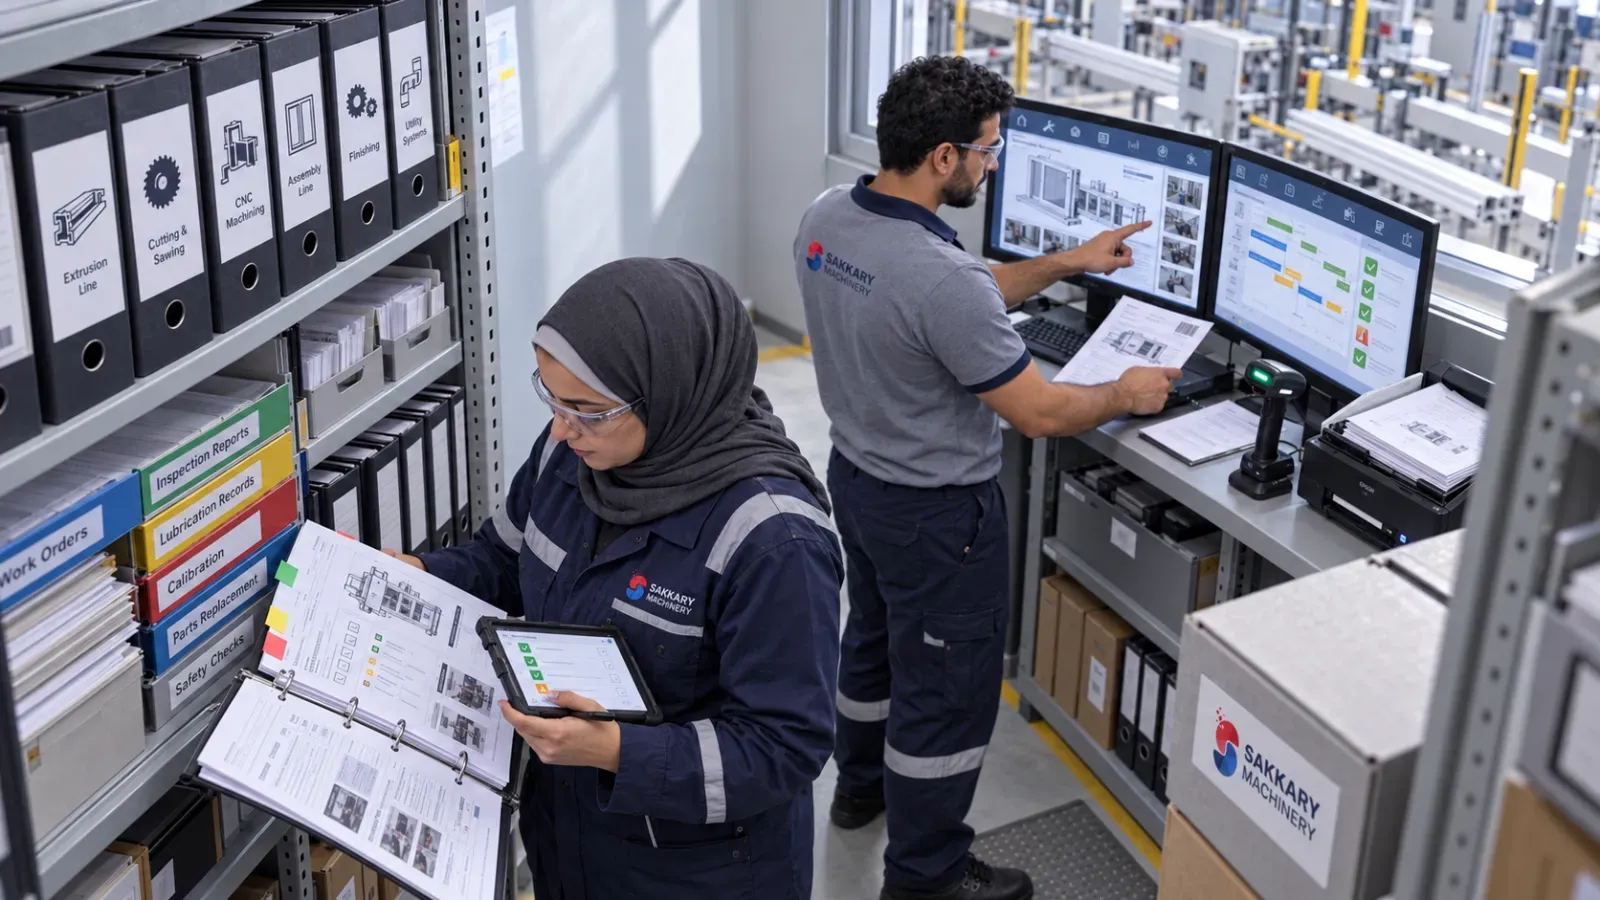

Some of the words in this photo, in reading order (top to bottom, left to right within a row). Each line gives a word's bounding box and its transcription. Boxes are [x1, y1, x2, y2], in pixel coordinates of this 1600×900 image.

[405, 116, 422, 131] Utility
[402, 128, 427, 146] Systems
[349, 141, 380, 162] Finishing
[288, 164, 321, 187] Assembly
[235, 192, 253, 208] CNC
[298, 183, 314, 197] Line
[226, 205, 265, 229] Machining
[148, 230, 179, 250] Cutting
[181, 225, 188, 236] &
[154, 244, 185, 265] Sawing
[63, 258, 108, 284] Extrusion
[824, 265, 872, 297] MACHINERY
[825, 252, 876, 286] SAKKARY
[78, 280, 98, 296] Line
[156, 451, 210, 491] Inspection
[212, 427, 249, 456] Reports
[160, 502, 217, 546] Lubrication
[218, 476, 255, 506] Records
[0, 556, 37, 588] Work
[41, 527, 88, 562] Orders
[167, 549, 225, 594] Calibration
[645, 593, 692, 615] MACHINERY
[649, 583, 696, 606] SAKKARY
[173, 620, 198, 645] Parts
[200, 574, 259, 625] Replacement
[175, 664, 208, 696] Safety
[210, 634, 244, 667] Checks
[1244, 744, 1320, 820] SAKKARY
[1241, 765, 1316, 841] MACHINERY
